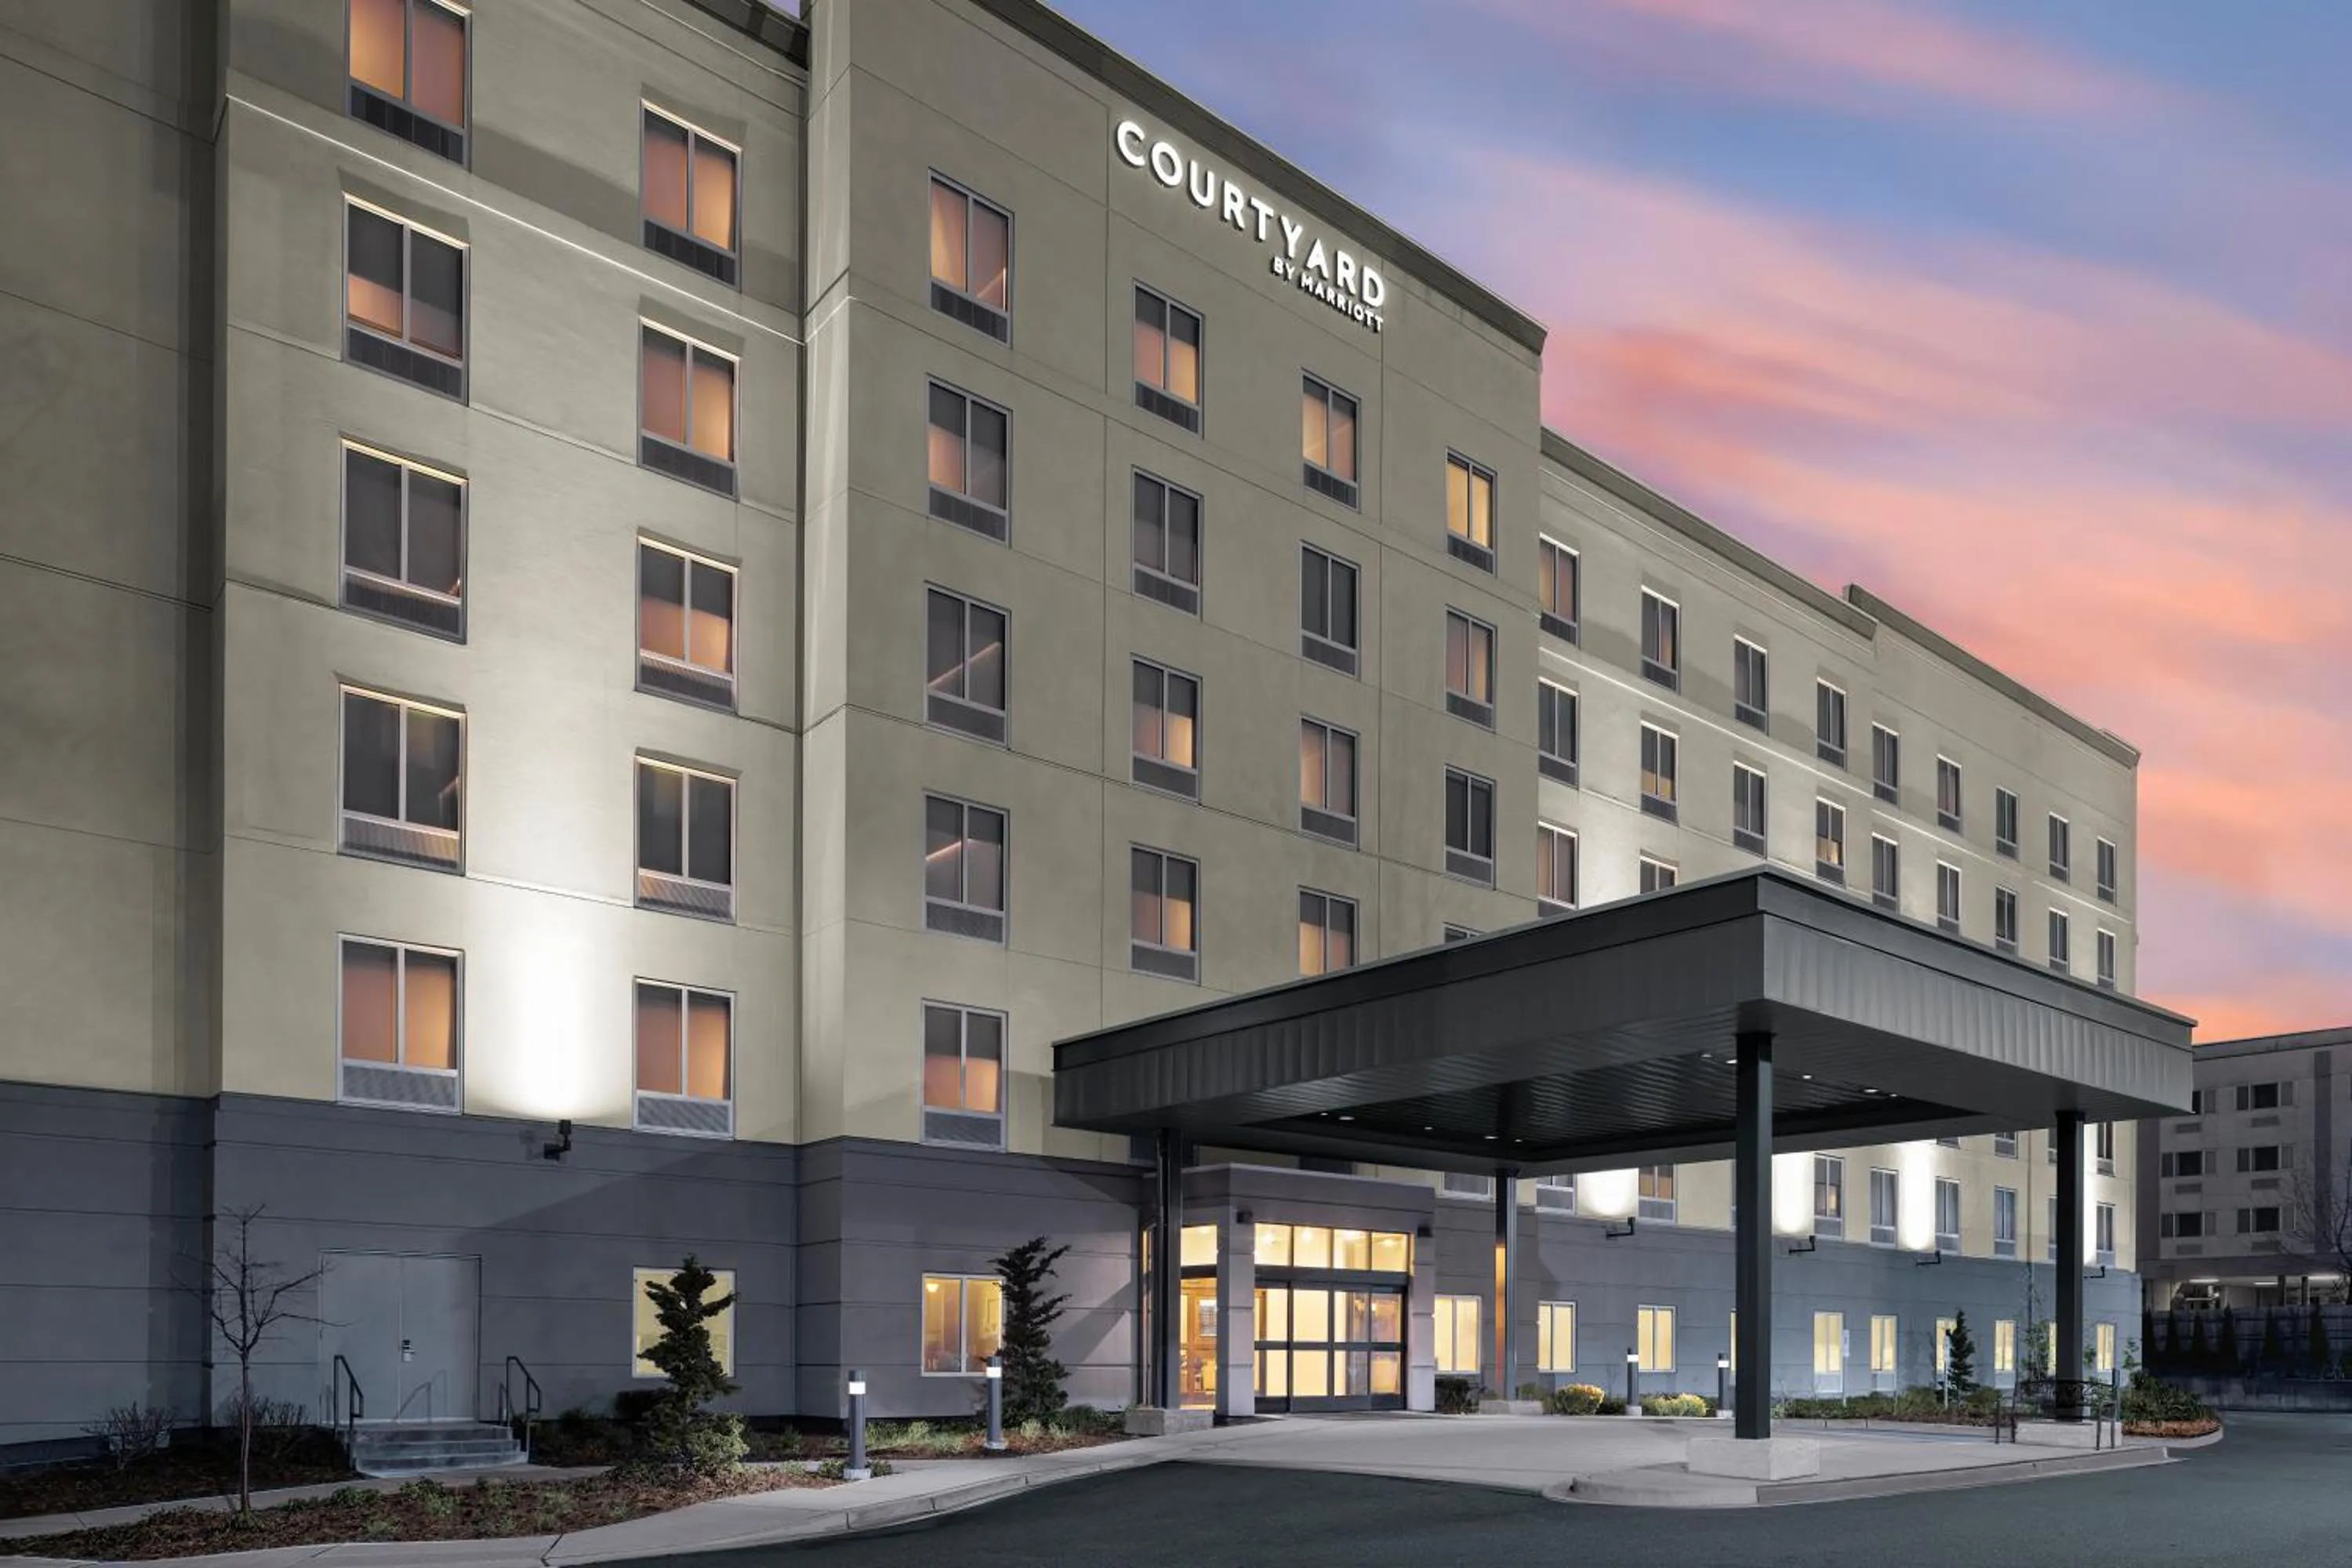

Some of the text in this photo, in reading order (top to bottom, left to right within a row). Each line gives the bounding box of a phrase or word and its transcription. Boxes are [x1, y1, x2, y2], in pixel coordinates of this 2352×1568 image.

[1116, 120, 1385, 307] COURTYARD
[1272, 256, 1384, 332] BY MARRIOTT
